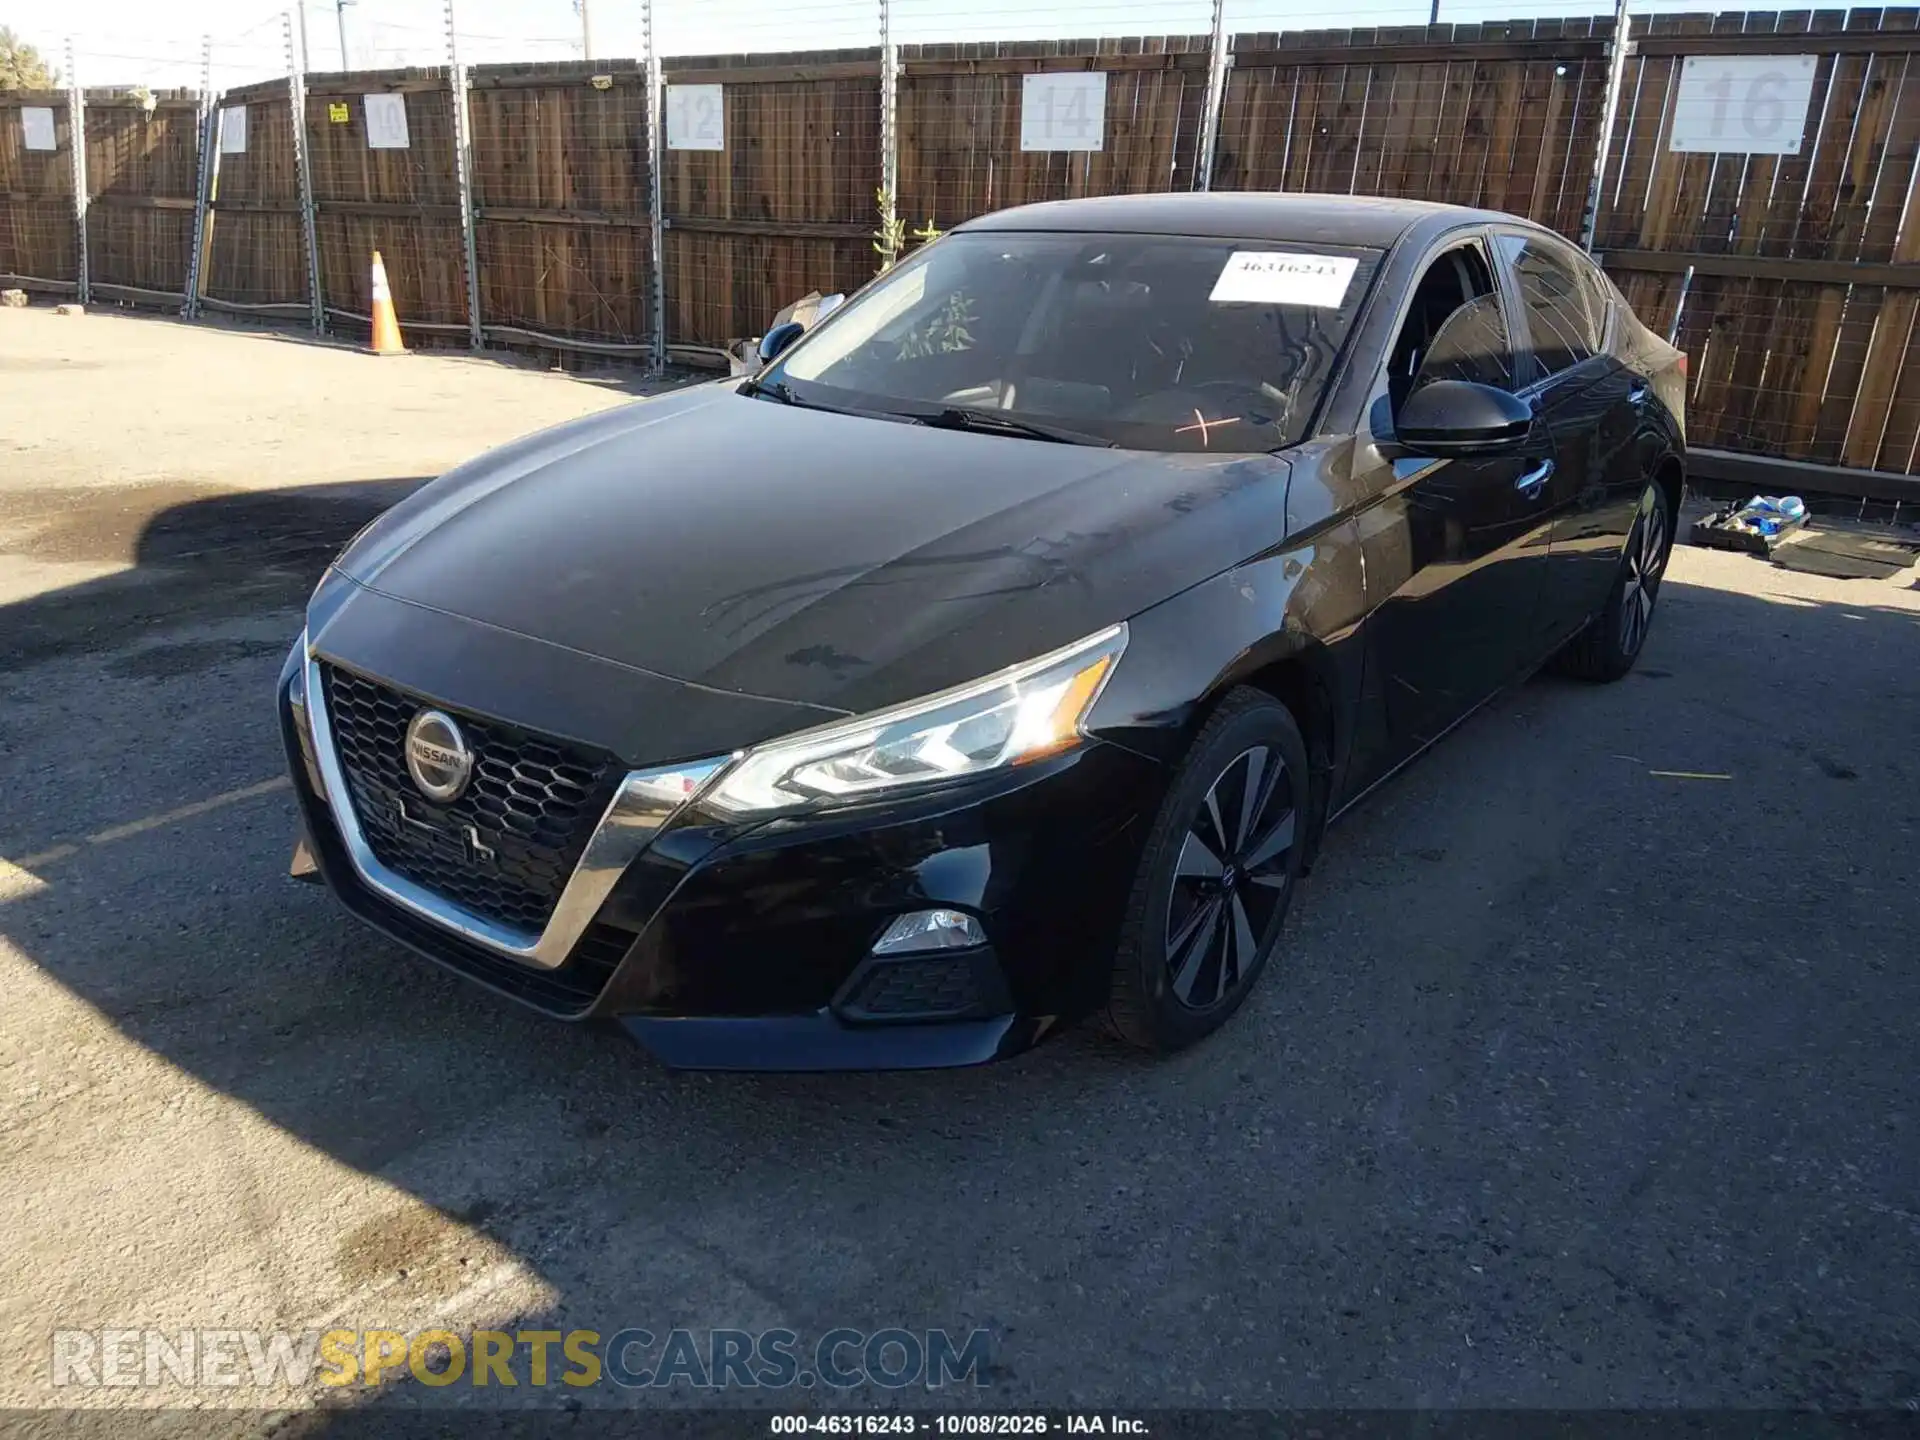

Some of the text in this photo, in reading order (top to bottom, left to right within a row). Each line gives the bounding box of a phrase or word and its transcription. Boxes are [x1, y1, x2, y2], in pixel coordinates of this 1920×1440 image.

[678, 94, 715, 139] 12
[1037, 86, 1092, 138] 14
[1703, 71, 1789, 138] 16
[412, 740, 464, 768] NISSAN
